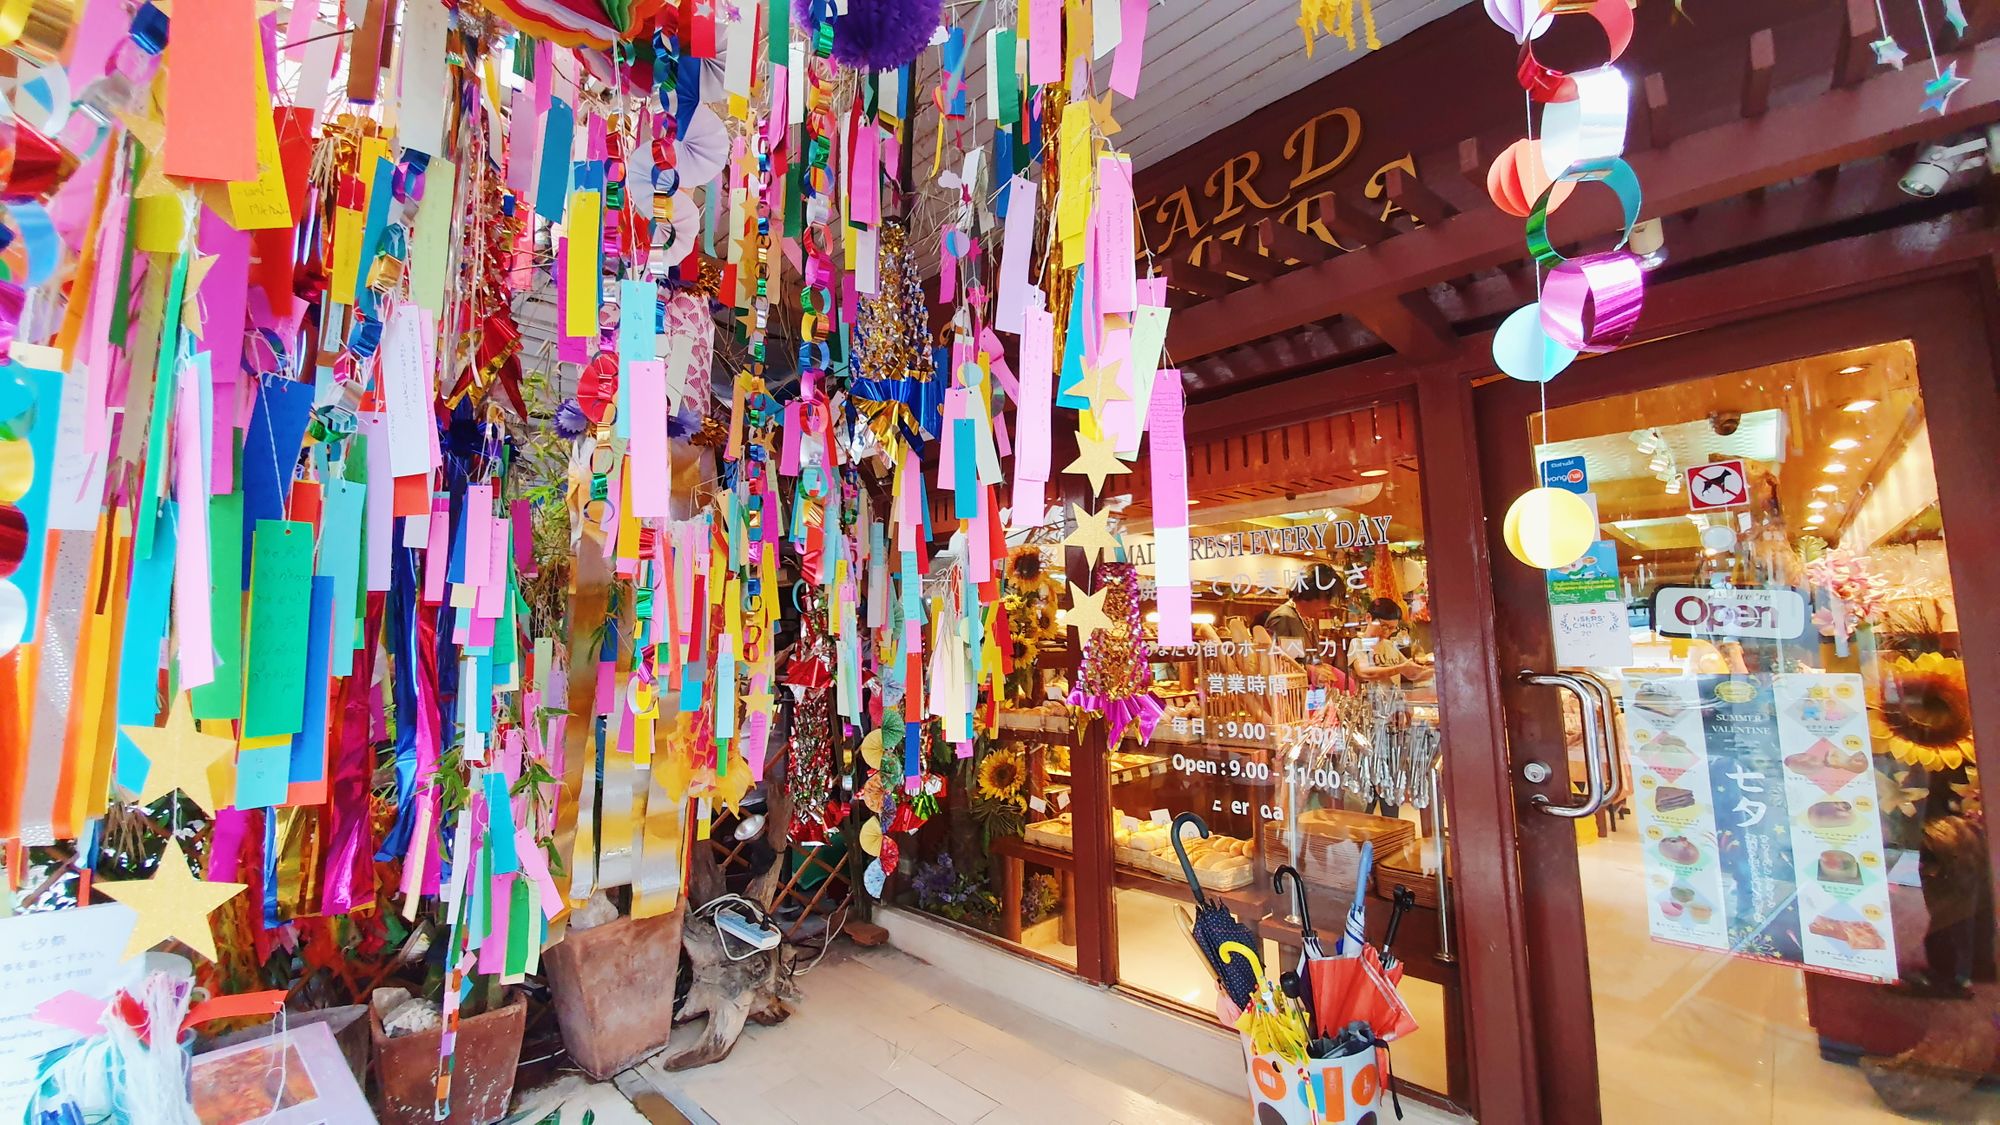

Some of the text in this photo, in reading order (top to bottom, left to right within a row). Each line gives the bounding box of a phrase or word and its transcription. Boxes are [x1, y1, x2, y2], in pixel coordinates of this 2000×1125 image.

[1190, 531, 1244, 561] RESH
[1249, 522, 1328, 556] EVERY
[1333, 514, 1392, 549] DAY
[1674, 595, 1778, 632] Open
[1207, 673, 1289, 697] 営業時間
[1172, 716, 1206, 737] 毎日
[1715, 714, 1762, 723] SUMMER
[1711, 725, 1771, 736] VALENTINE
[1172, 753, 1217, 776] Open
[1725, 763, 1767, 828] 七夕
